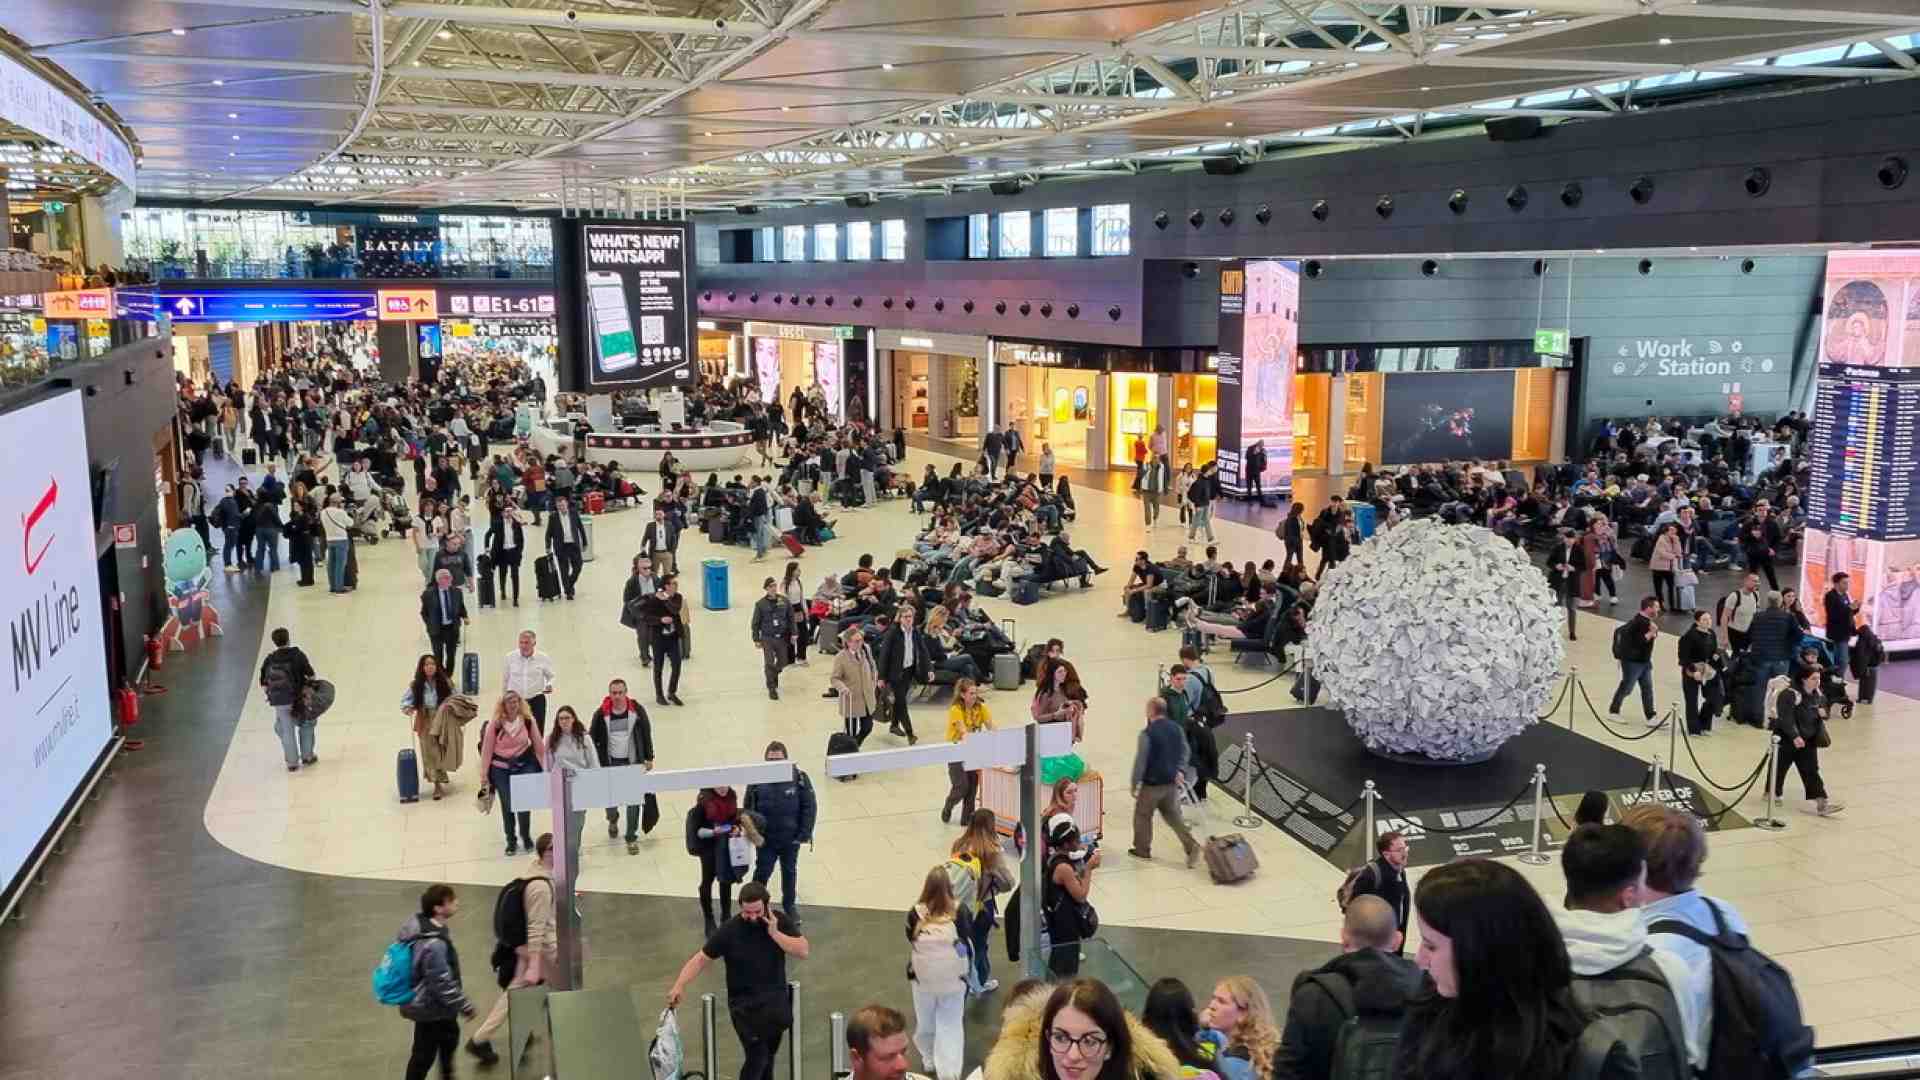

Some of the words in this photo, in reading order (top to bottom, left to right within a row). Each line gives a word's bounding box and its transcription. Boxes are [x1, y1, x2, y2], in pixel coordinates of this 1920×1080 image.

[364, 240, 433, 251] EATALY
[589, 233, 641, 248] WHAT'S
[643, 234, 679, 249] NEW?
[1636, 339, 1694, 358] Work
[1657, 357, 1731, 376] Station
[10, 599, 41, 693] MV
[44, 579, 81, 658] Line
